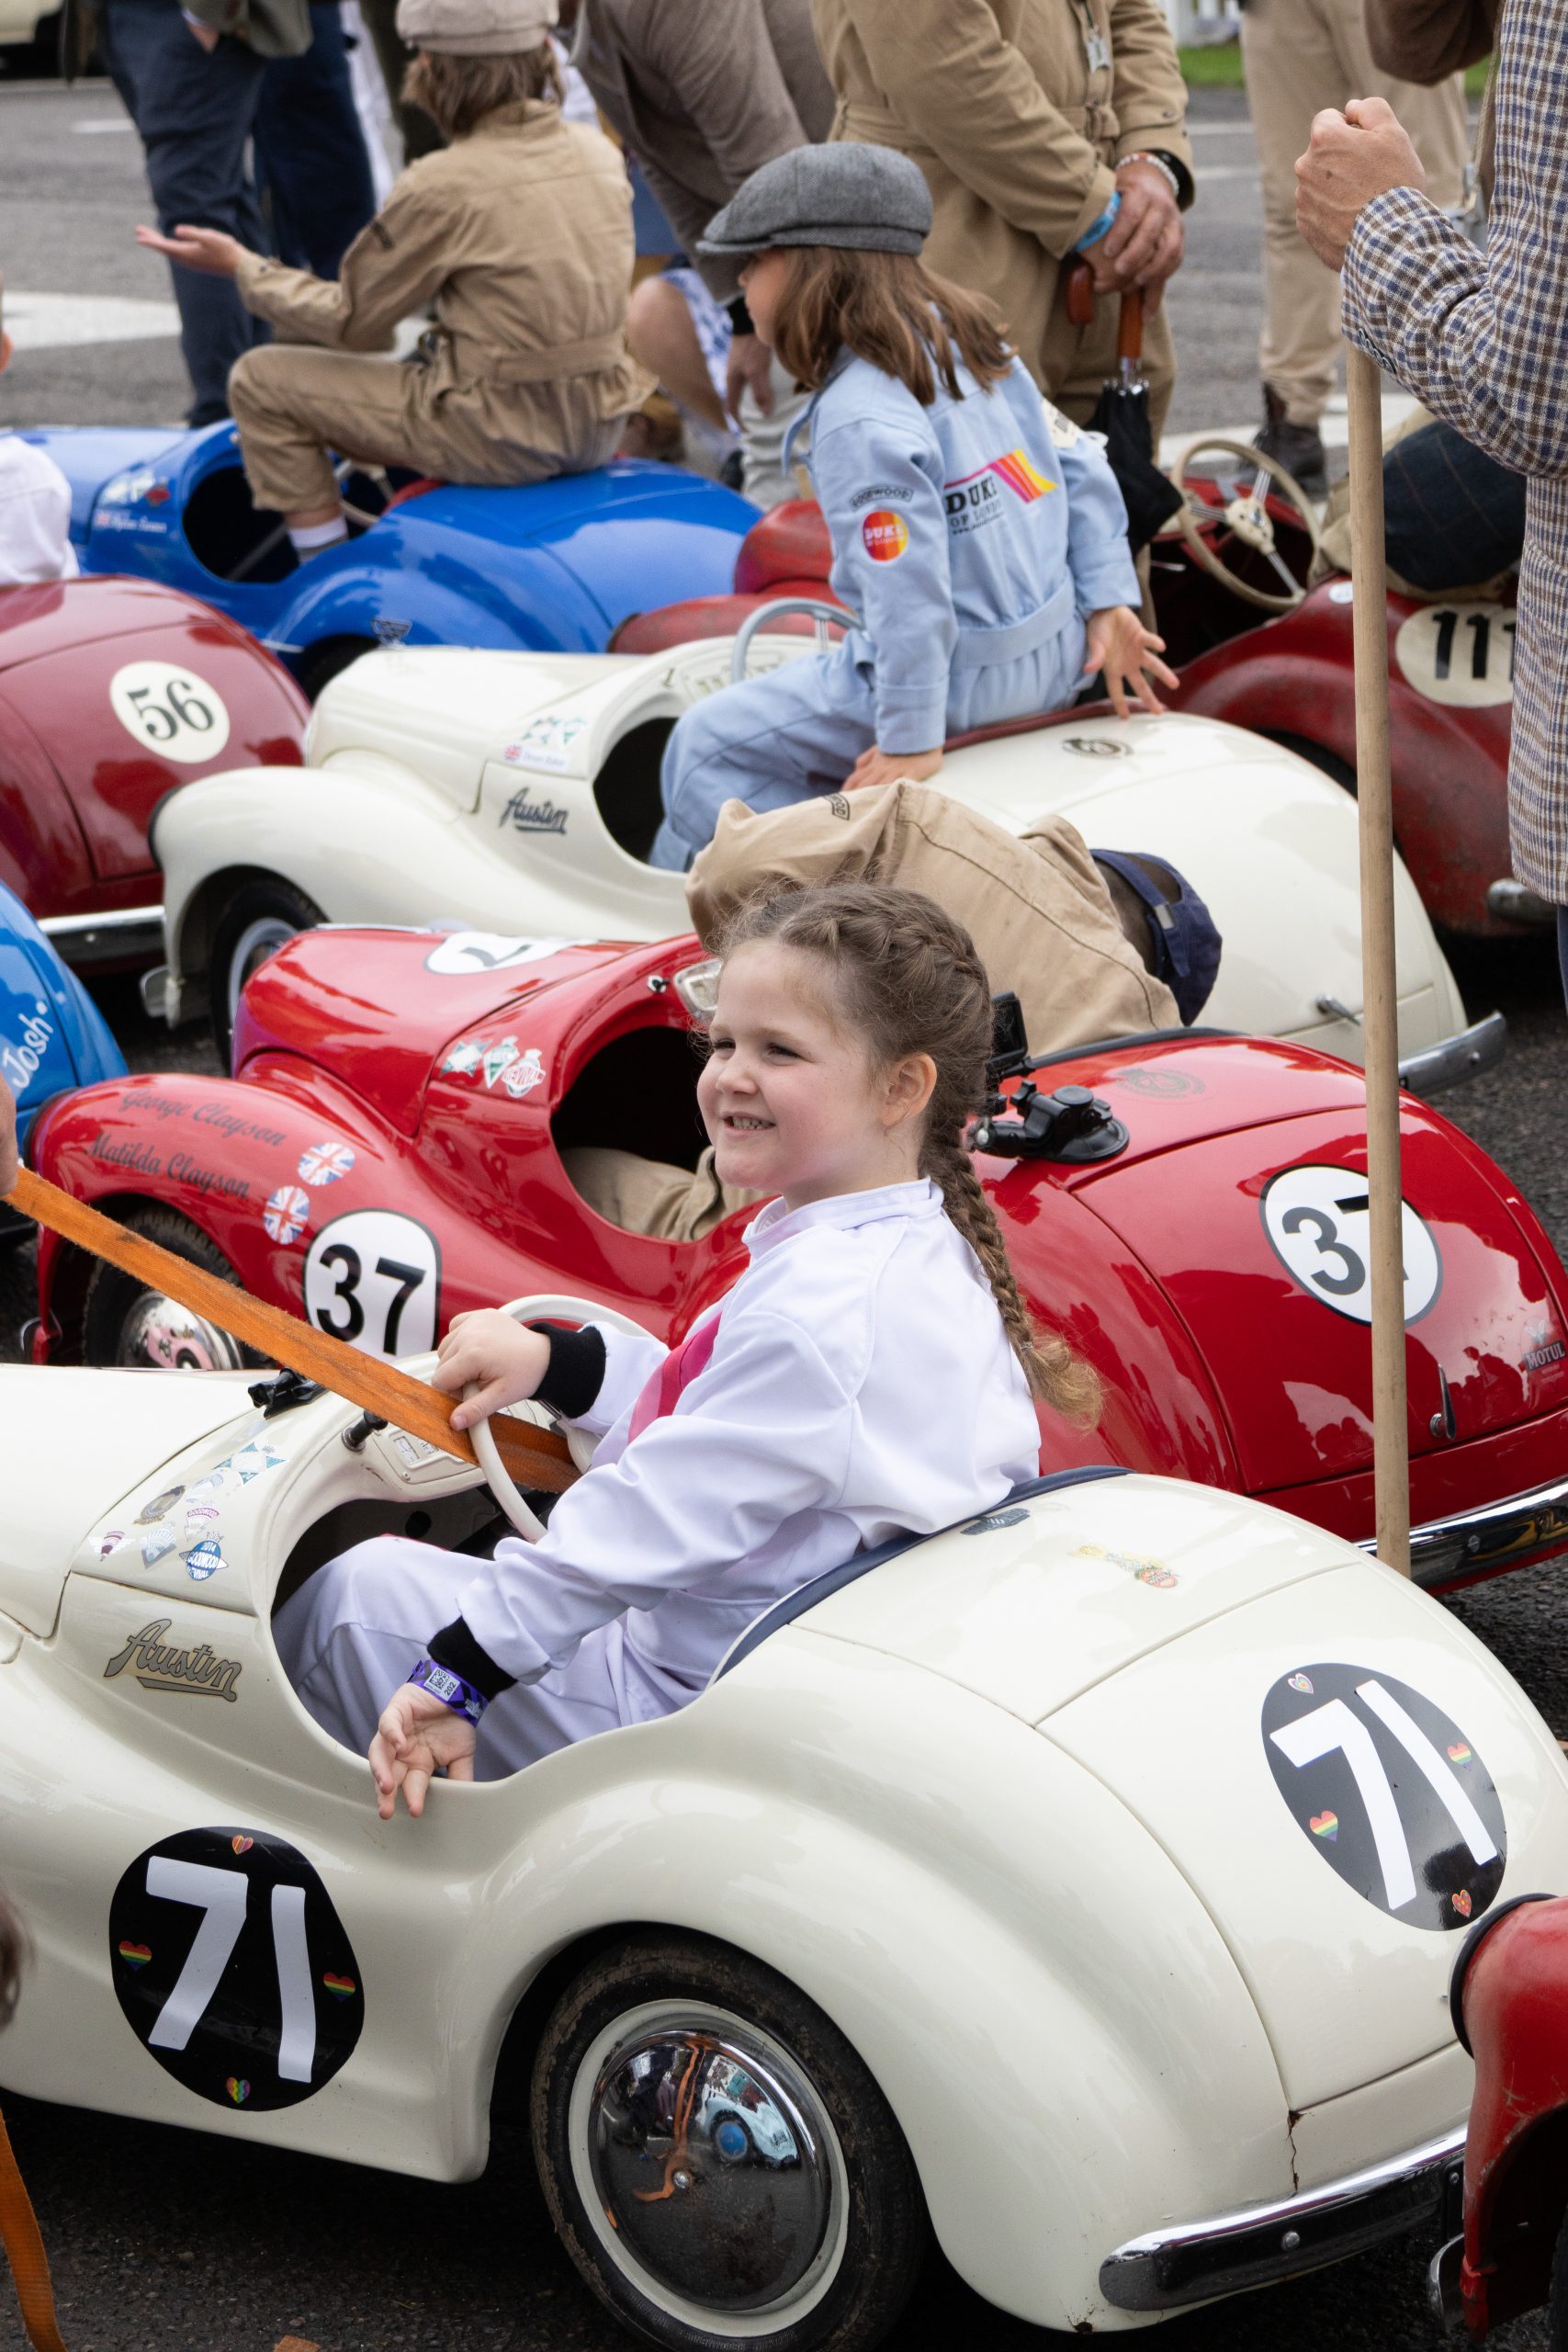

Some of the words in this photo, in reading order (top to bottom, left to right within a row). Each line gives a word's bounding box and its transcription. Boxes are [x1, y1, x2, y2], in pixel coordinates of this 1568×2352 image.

[127, 680, 215, 741] 56
[499, 786, 569, 836] Austin
[2, 1012, 54, 1089] Josh
[118, 1087, 185, 1121] George
[193, 1101, 288, 1148] Clayson
[84, 1130, 161, 1175] Matilda
[167, 1152, 250, 1199] Clayson
[316, 1244, 427, 1356] 37
[1527, 1342, 1566, 1370] MOTUL
[104, 1618, 243, 1702] Austin
[1269, 1679, 1498, 1910] 71
[146, 1855, 316, 2083] 71
